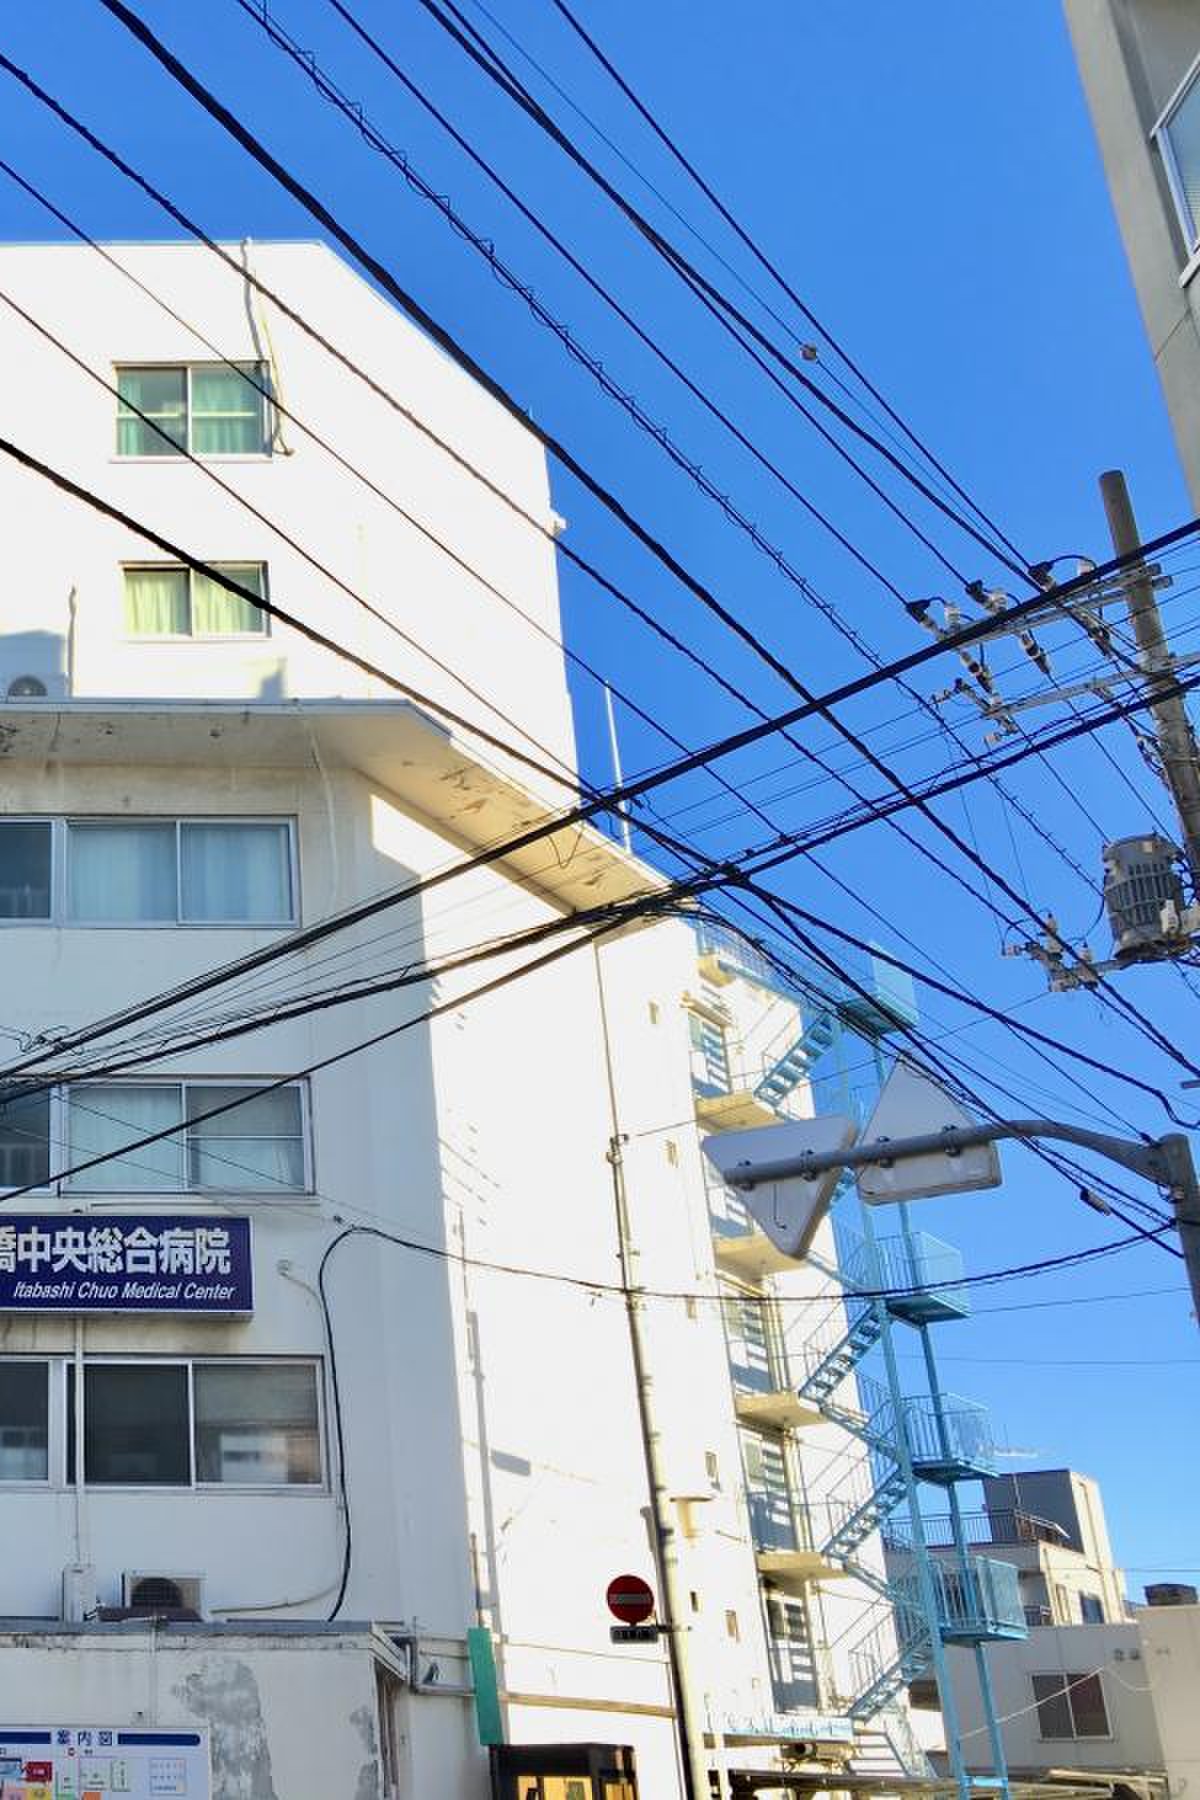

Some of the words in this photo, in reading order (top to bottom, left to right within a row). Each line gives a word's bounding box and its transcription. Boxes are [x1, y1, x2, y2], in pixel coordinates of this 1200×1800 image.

[13, 1281, 75, 1300] Itabashi
[77, 1281, 118, 1300] Chuo
[120, 1281, 180, 1300] Medical
[182, 1282, 235, 1301] Center
